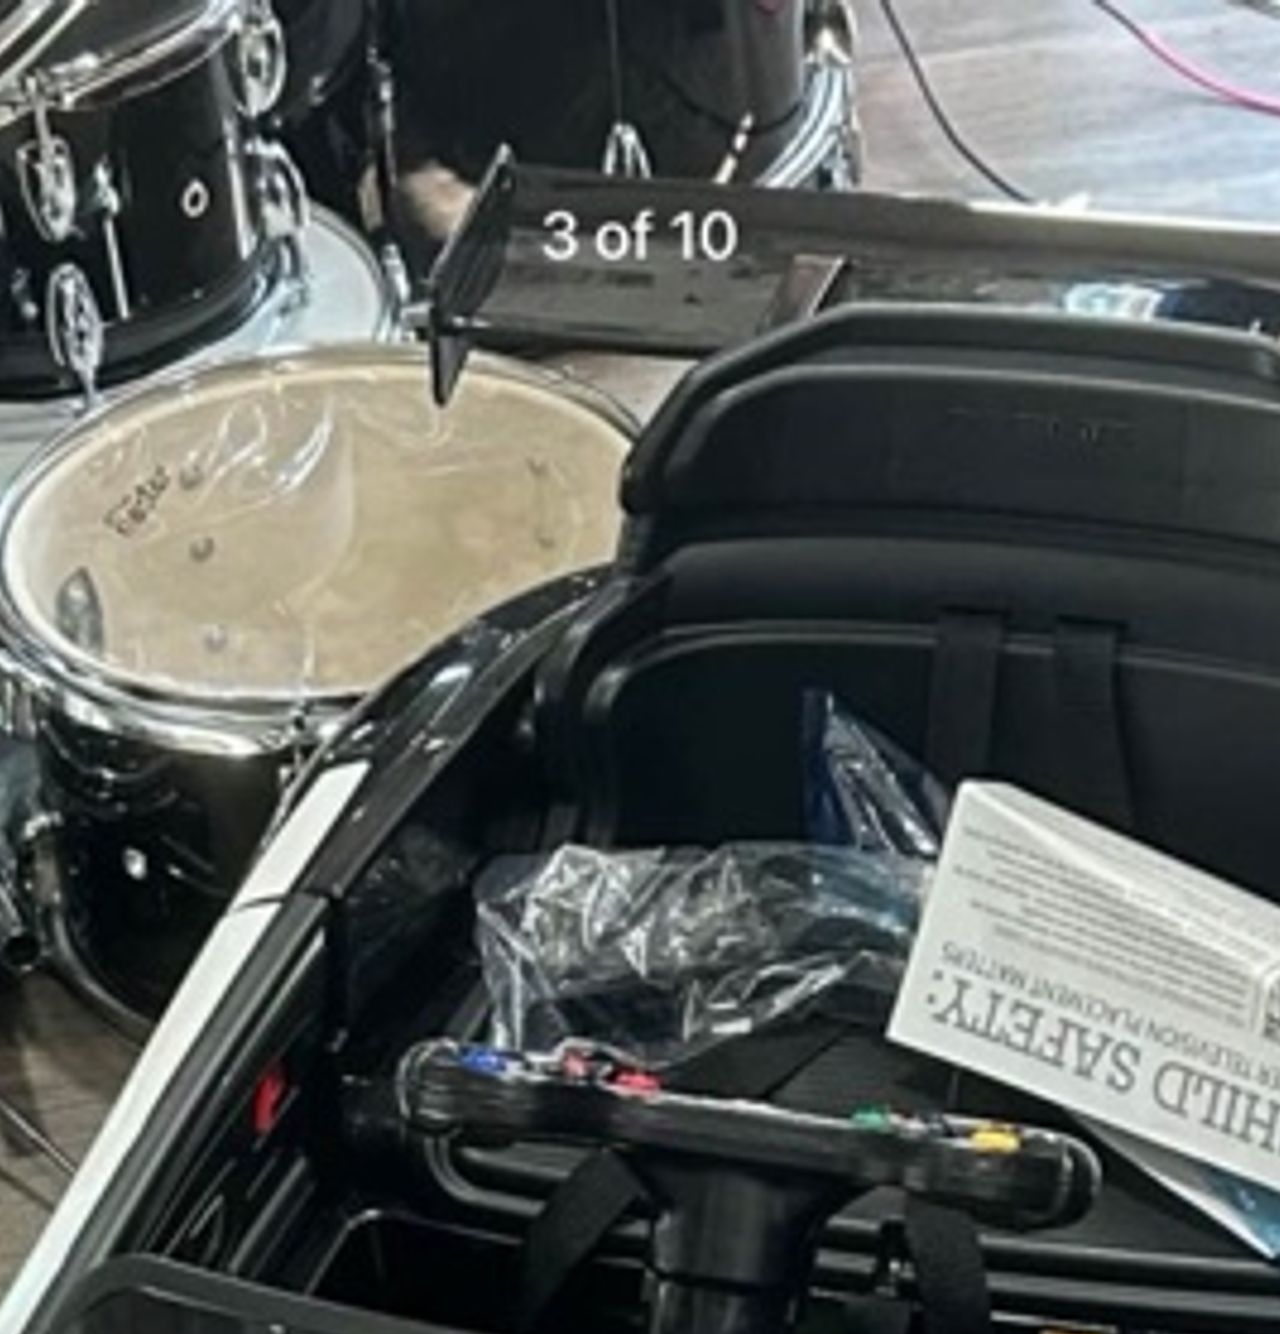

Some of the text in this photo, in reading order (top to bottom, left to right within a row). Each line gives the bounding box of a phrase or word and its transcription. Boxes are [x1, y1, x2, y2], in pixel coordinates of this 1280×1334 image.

[940, 941, 1028, 990] MATTERS
[926, 969, 1141, 1094] SAFETY:
[1030, 972, 1146, 1037] PLACEMENT
[1142, 1018, 1255, 1081] TELEVISION
